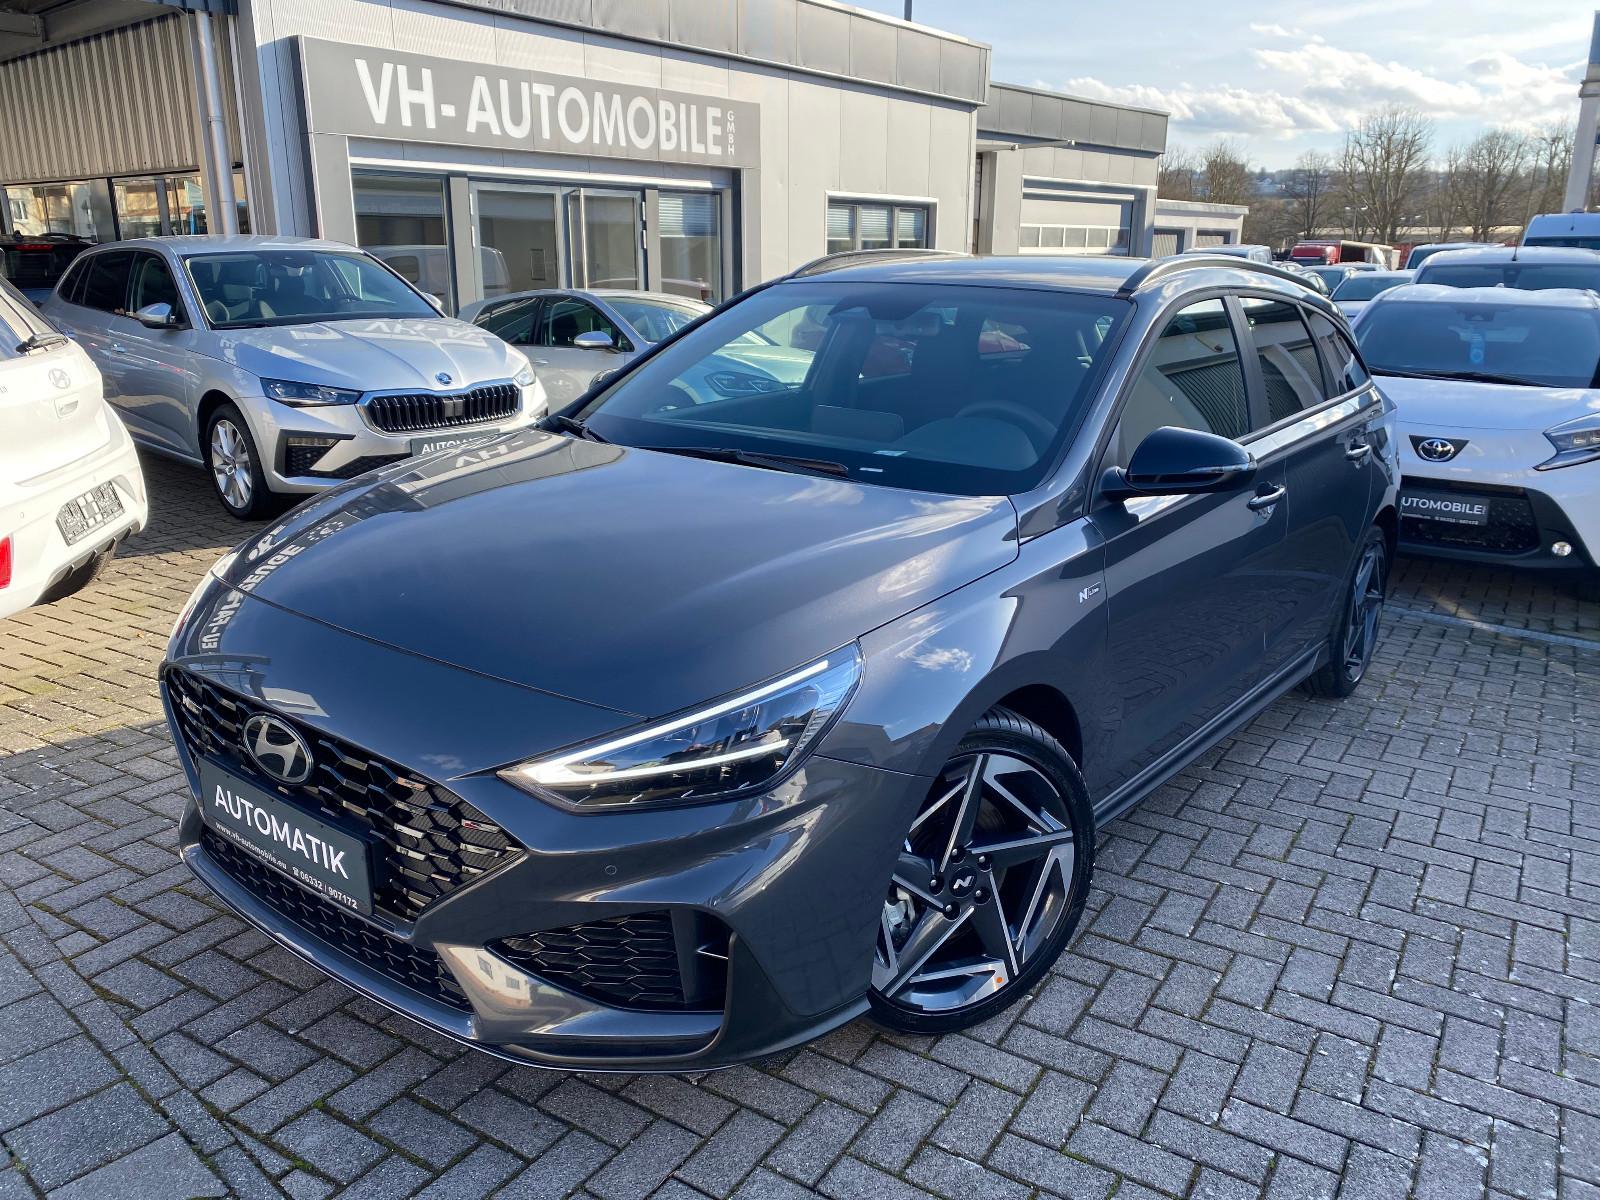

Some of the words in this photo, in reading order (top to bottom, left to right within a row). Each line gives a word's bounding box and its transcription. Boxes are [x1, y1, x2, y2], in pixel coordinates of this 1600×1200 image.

[354, 58, 456, 129] VH-
[466, 75, 722, 155] AUTOMOBILE
[727, 110, 736, 156] GMBH
[1401, 496, 1483, 515] UTOMOBILE
[215, 784, 349, 880] AUTOMATIK
[215, 821, 288, 869] www.vh-automobile.eu
[300, 871, 323, 891] 06332
[328, 886, 358, 910] 907172
